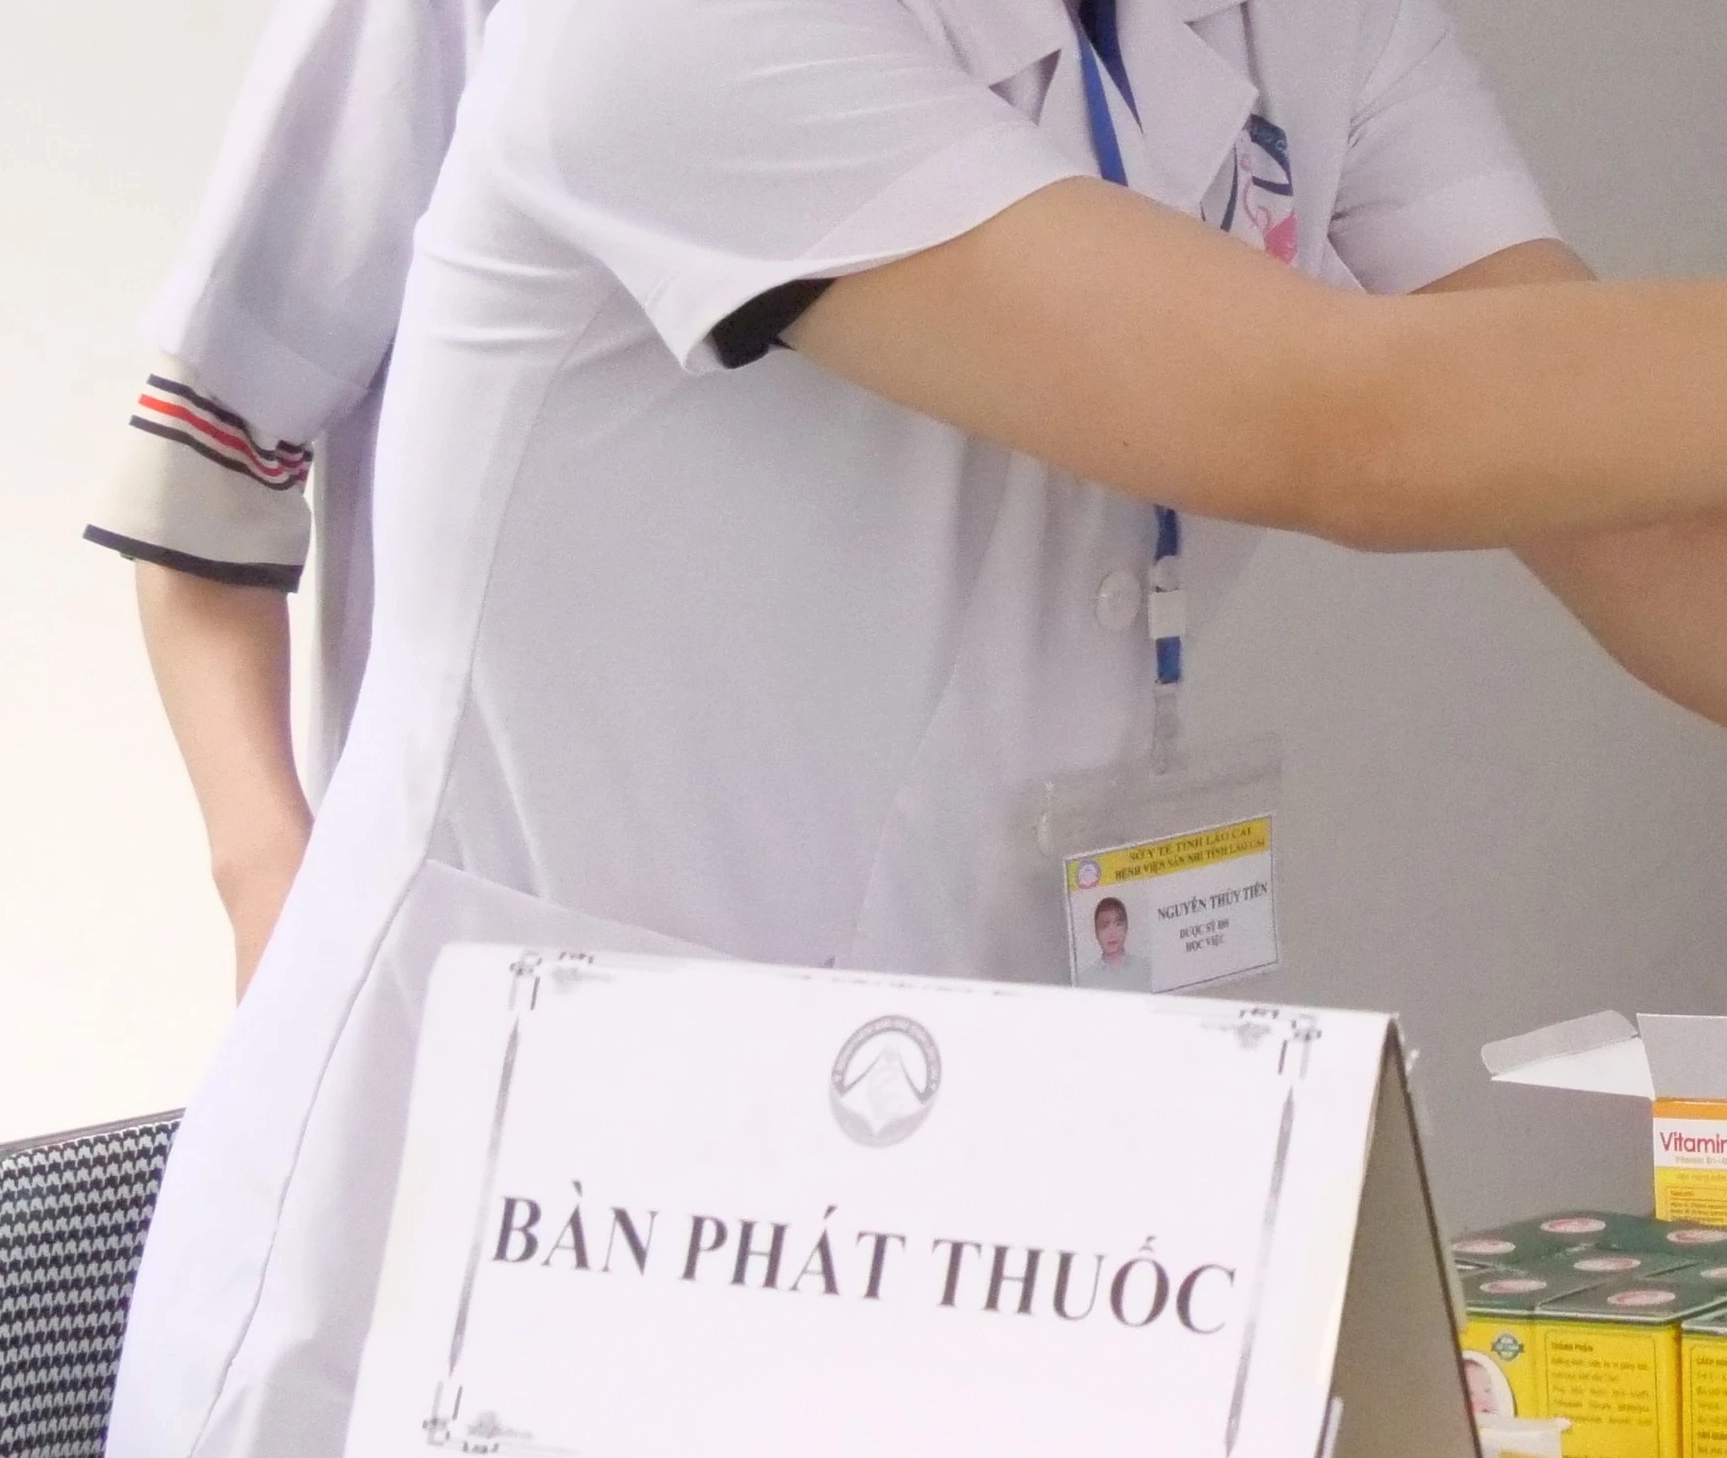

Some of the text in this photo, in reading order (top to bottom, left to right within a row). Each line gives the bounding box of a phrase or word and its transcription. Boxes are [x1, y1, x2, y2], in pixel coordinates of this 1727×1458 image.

[492, 1180, 1239, 1337] BÀN PHÁT THUỐC
